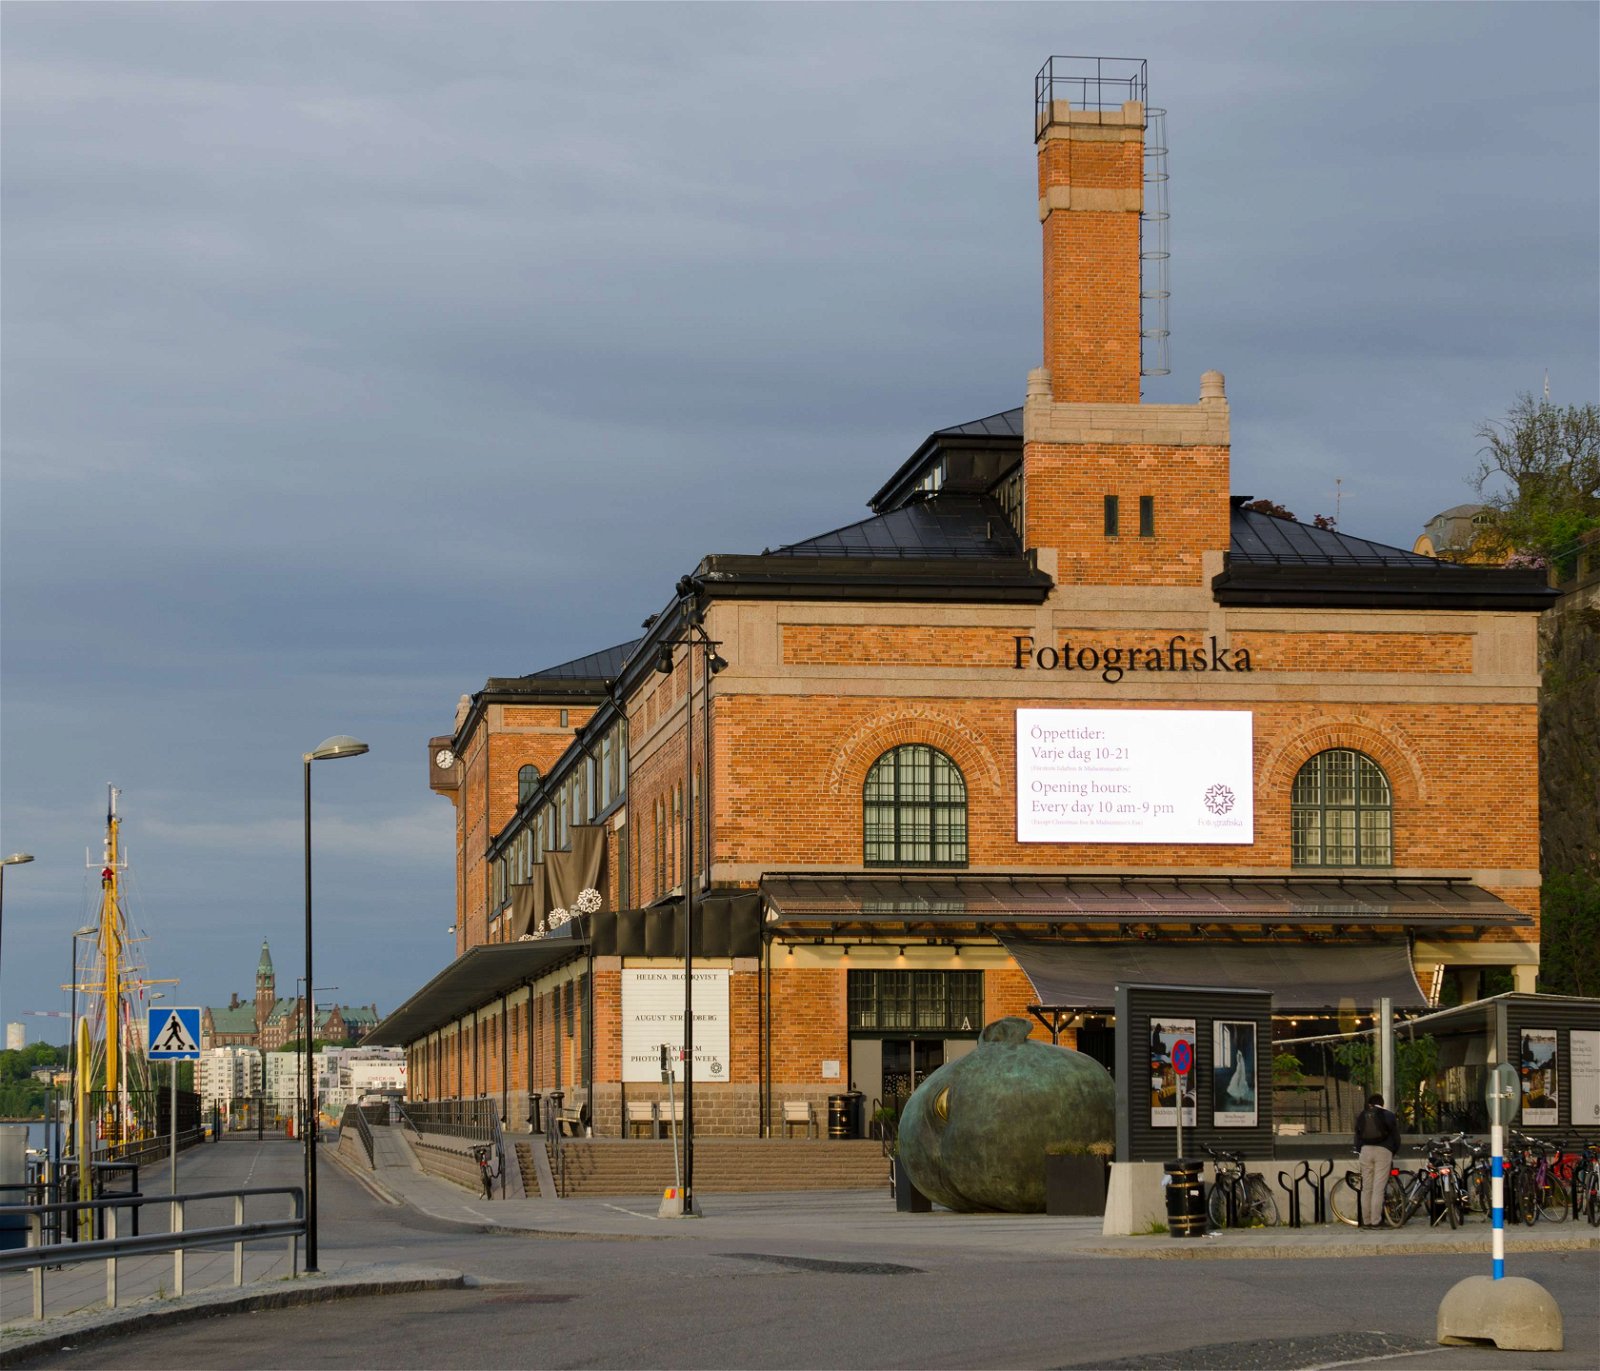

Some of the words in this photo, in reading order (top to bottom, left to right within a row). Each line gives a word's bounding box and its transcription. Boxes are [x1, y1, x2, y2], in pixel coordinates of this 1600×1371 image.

[1012, 635, 1253, 684] Fotografiska
[1030, 724, 1105, 743] Öppettider:
[1031, 746, 1065, 762] Varje
[1068, 746, 1092, 763] dag
[1096, 747, 1129, 760] 10-21
[1031, 780, 1088, 797] Opening
[1091, 780, 1131, 793] hours:
[1032, 800, 1068, 816] Every
[1071, 800, 1094, 816] day
[1099, 801, 1113, 813] 10
[1153, 804, 1175, 817] pm
[961, 1016, 971, 1030] A
